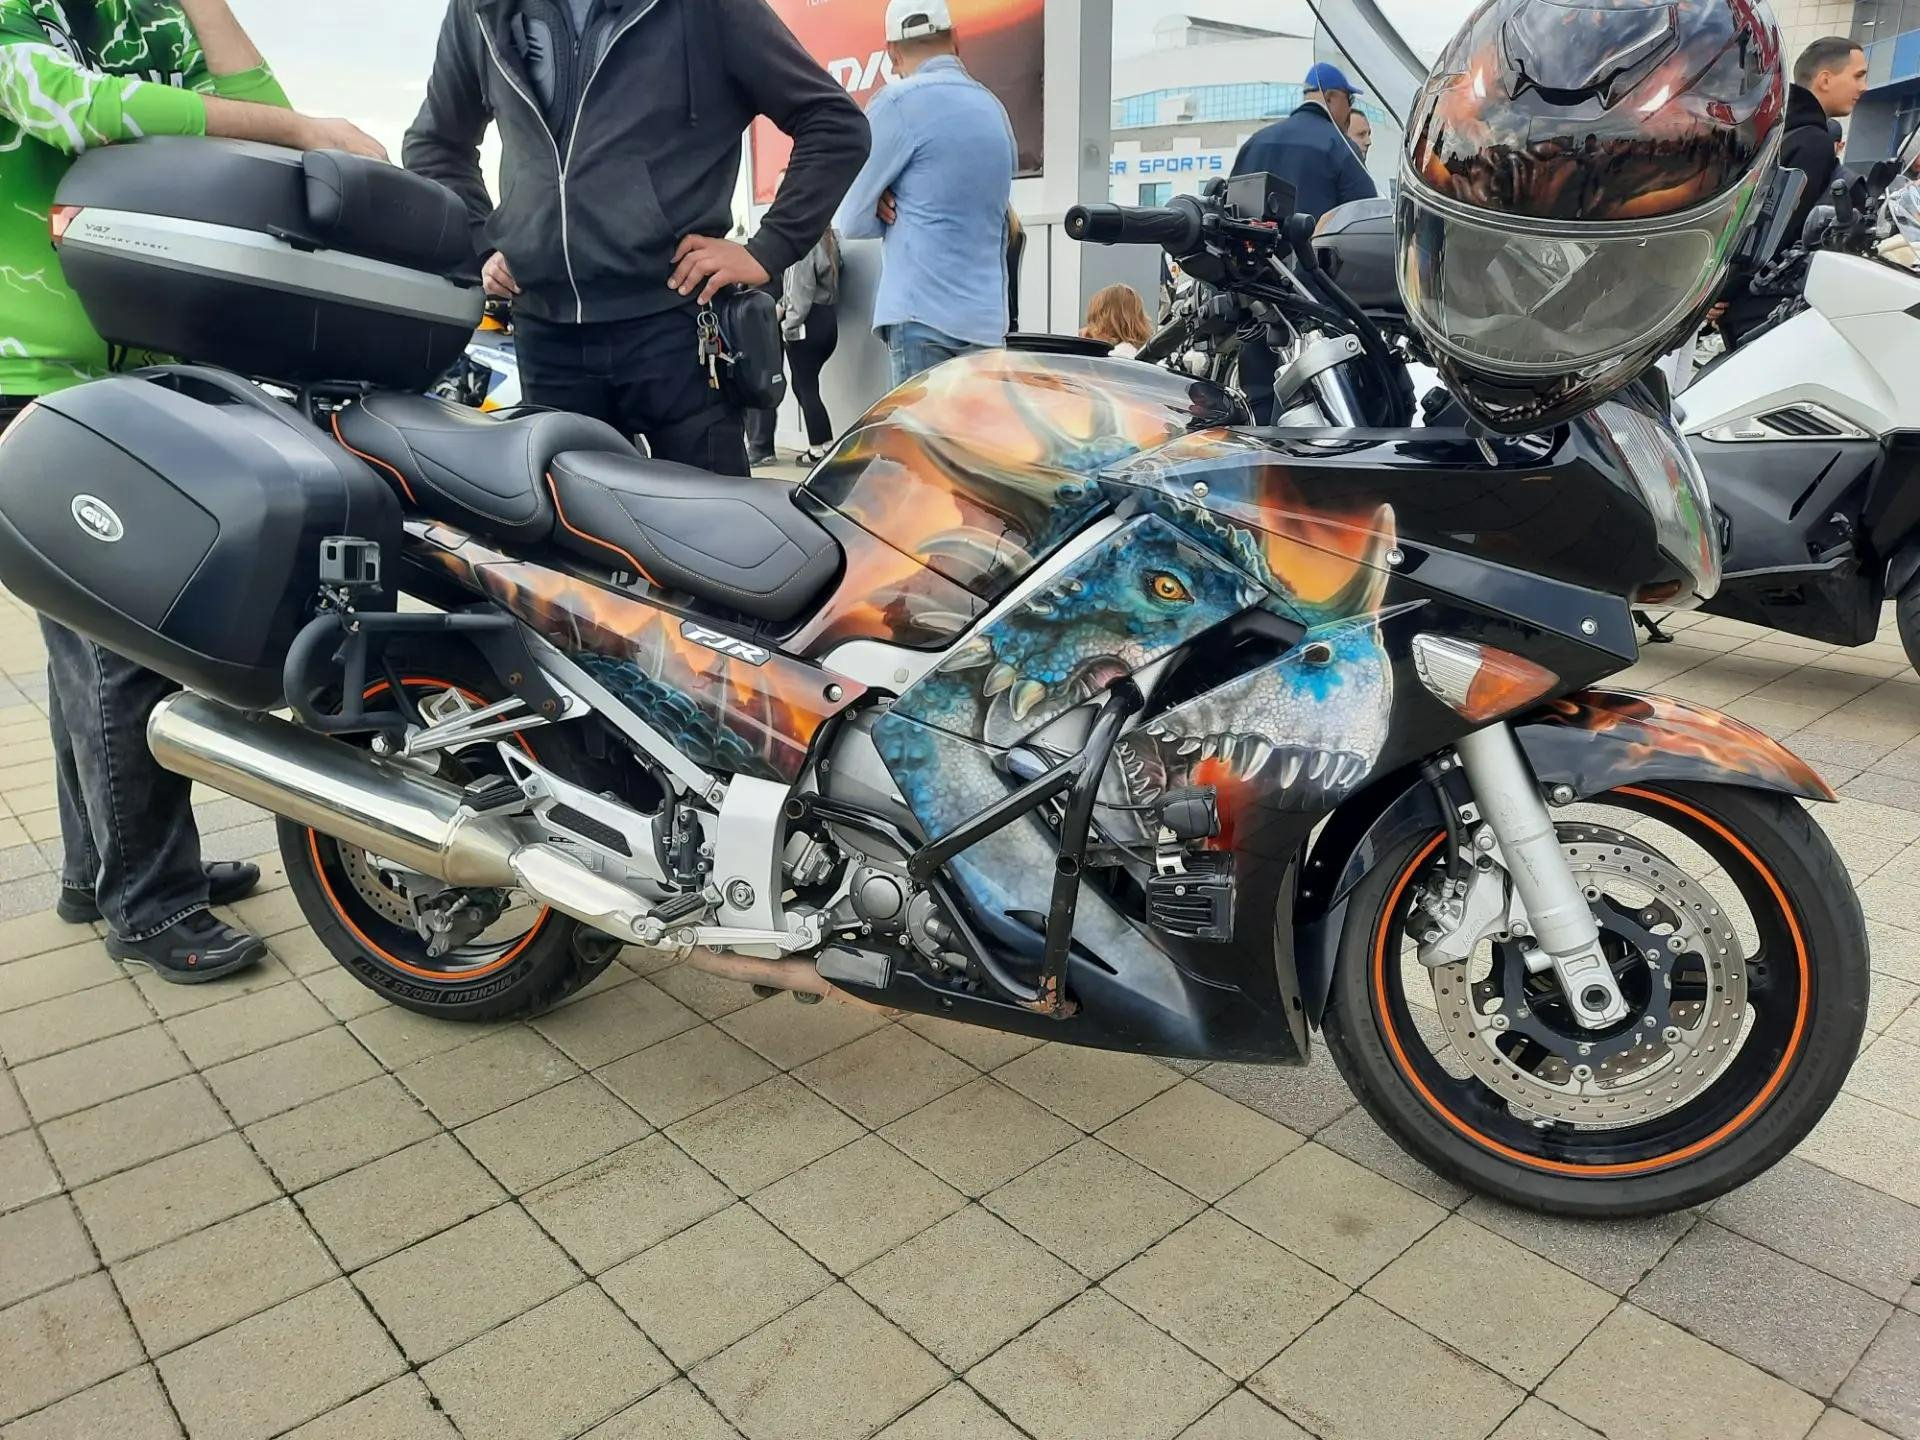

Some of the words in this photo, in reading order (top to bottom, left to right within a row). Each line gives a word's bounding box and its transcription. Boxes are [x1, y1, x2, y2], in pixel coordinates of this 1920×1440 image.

[1139, 156, 1222, 173] SPORTS
[84, 223, 111, 233] V47
[684, 624, 765, 662] FJR
[447, 974, 512, 1003] MICHELIN
